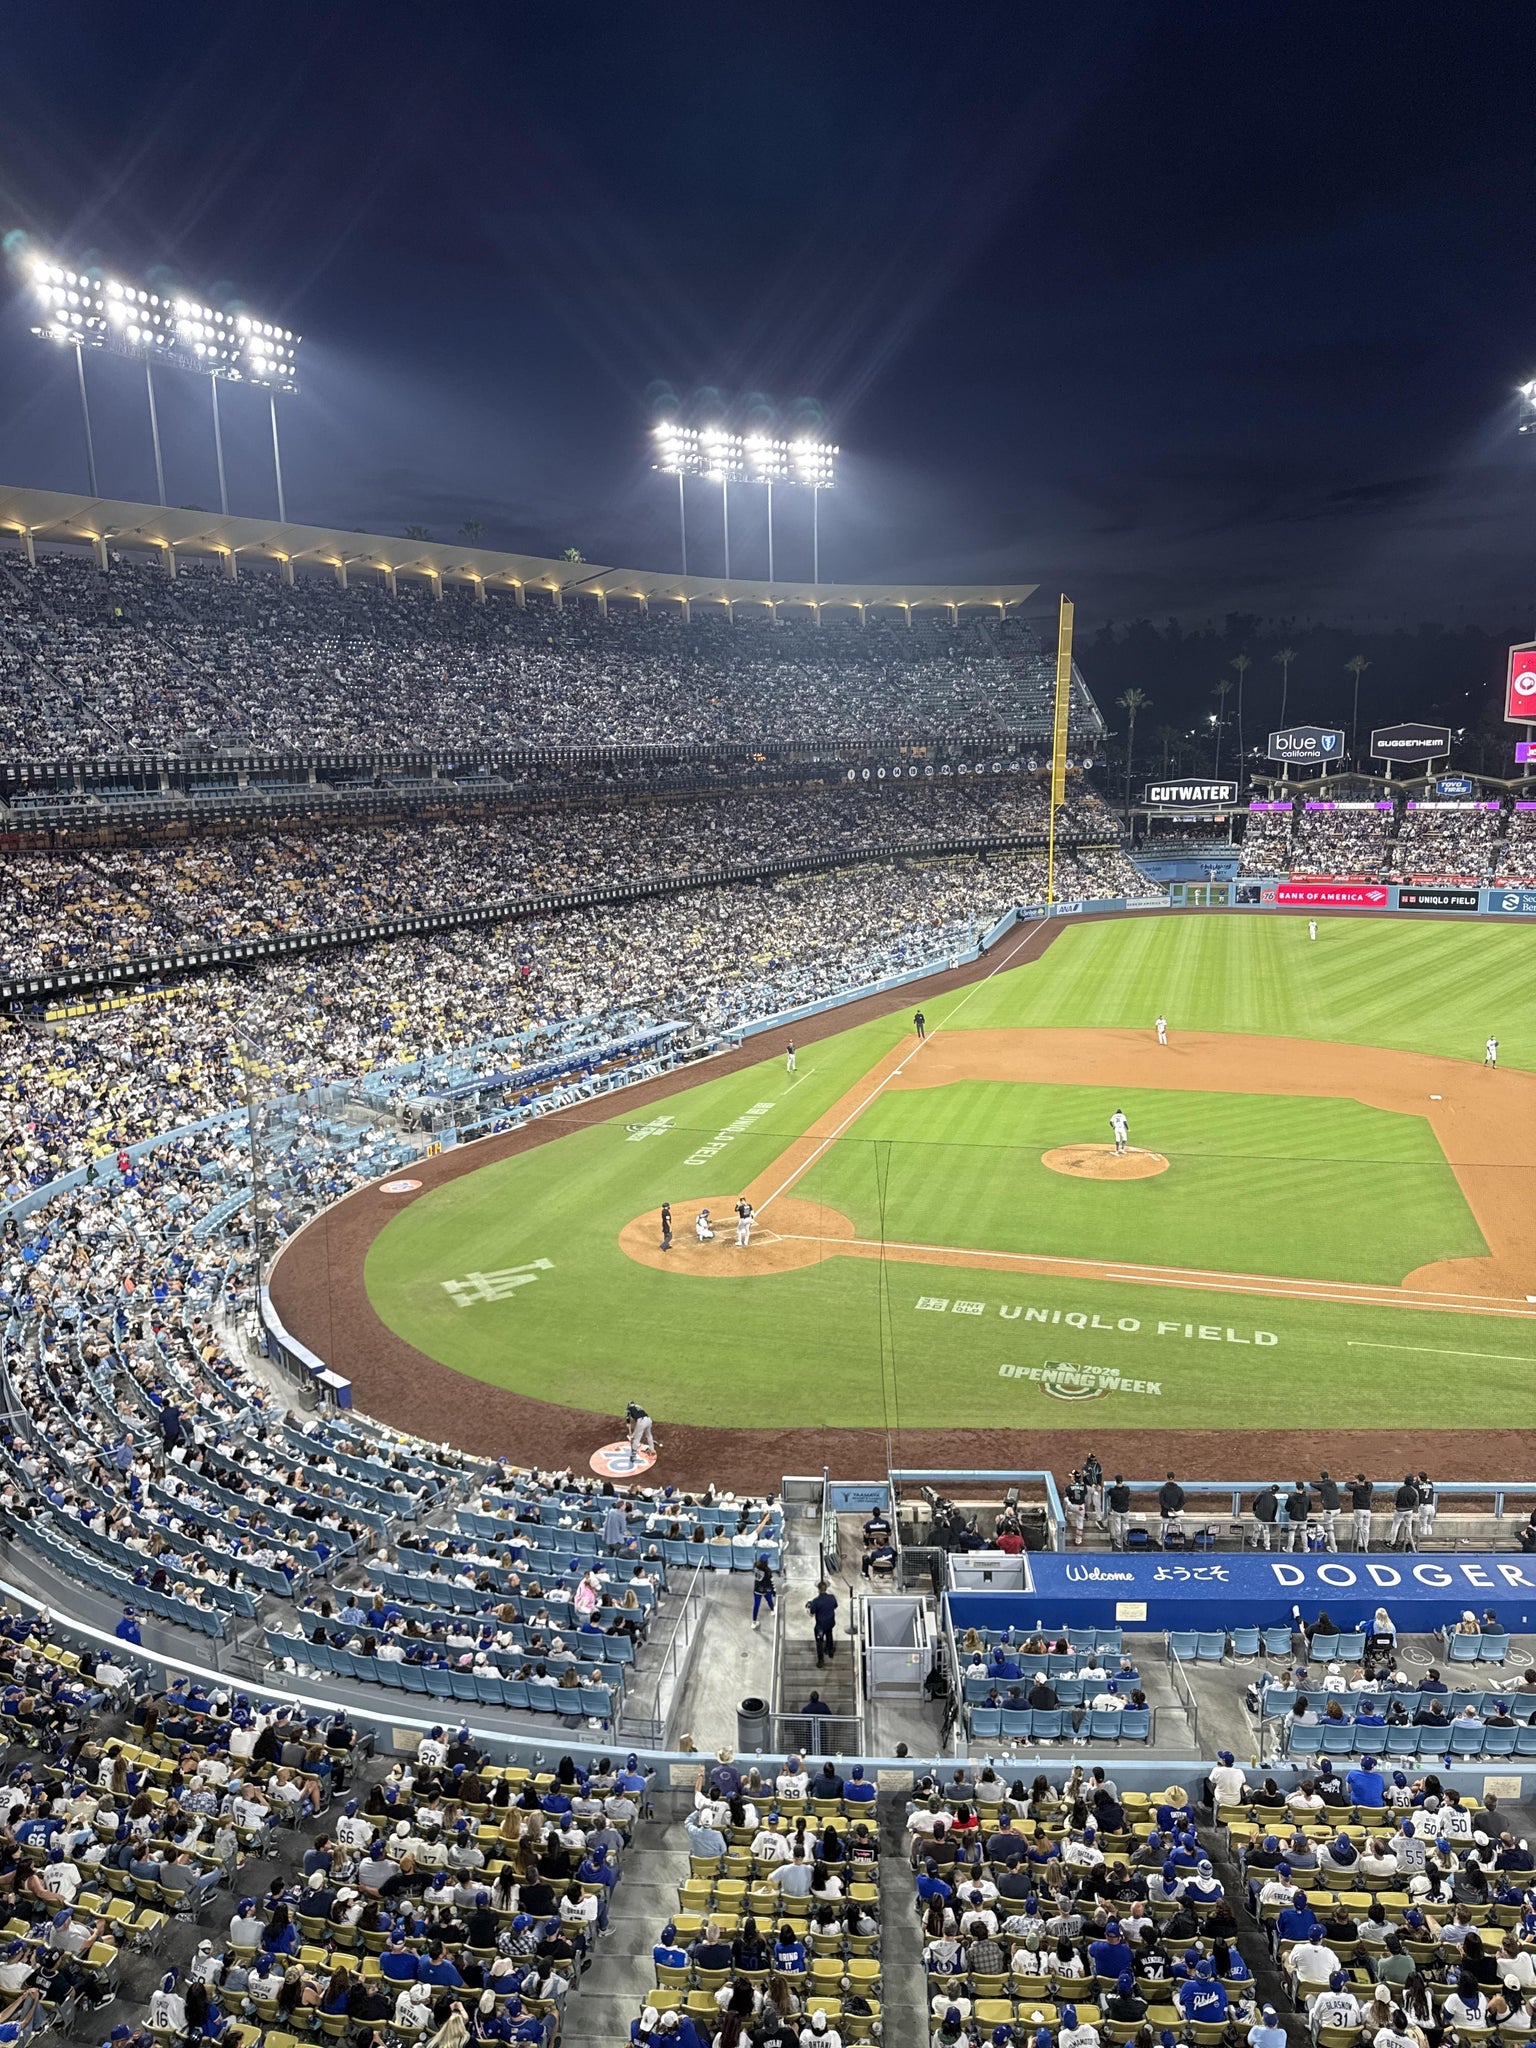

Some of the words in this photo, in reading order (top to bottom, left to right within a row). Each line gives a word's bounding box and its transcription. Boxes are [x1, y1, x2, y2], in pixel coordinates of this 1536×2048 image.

[1276, 735, 1317, 750] blue
[1377, 739, 1443, 747] GUGGENHEIM
[1282, 750, 1320, 758] california
[1151, 786, 1230, 801] CUTWATER
[1263, 891, 1275, 900] 76
[1279, 892, 1305, 900] BANK
[1320, 893, 1364, 901] AMERICA
[1418, 896, 1449, 905] UNIQLO
[1451, 897, 1476, 905] FIELD
[1059, 905, 1073, 913] ANA
[714, 1116, 761, 1141] UNIQLO
[683, 1142, 729, 1166] FIELD
[999, 1305, 1141, 1333] UNIQLO
[1157, 1321, 1279, 1347] FIELD
[1082, 1365, 1121, 1377] 2026
[998, 1364, 1096, 1387] OPENING
[1099, 1376, 1163, 1396] WEEK
[1066, 1564, 1136, 1582] Welcome
[1153, 1565, 1230, 1582] ようこそ
[1271, 1563, 1536, 1587] DODGER
[421, 1752, 436, 1766] 28
[99, 1773, 107, 1786] 5
[784, 1790, 800, 1799] 99
[1397, 1797, 1410, 1807] 50
[1424, 1823, 1437, 1835] 50
[1452, 1819, 1467, 1833] 50
[28, 1834, 47, 1846] 66
[339, 1830, 354, 1844] 66
[394, 1848, 407, 1858] 17
[764, 1847, 775, 1860] 17
[1405, 1850, 1423, 1865] 55
[49, 1882, 61, 1895] 17
[1058, 1967, 1073, 1978] 50
[1144, 1966, 1164, 1980] 34
[156, 2012, 169, 2027] 16
[1333, 2012, 1348, 2028] 31
[1466, 2008, 1482, 2021] 50
